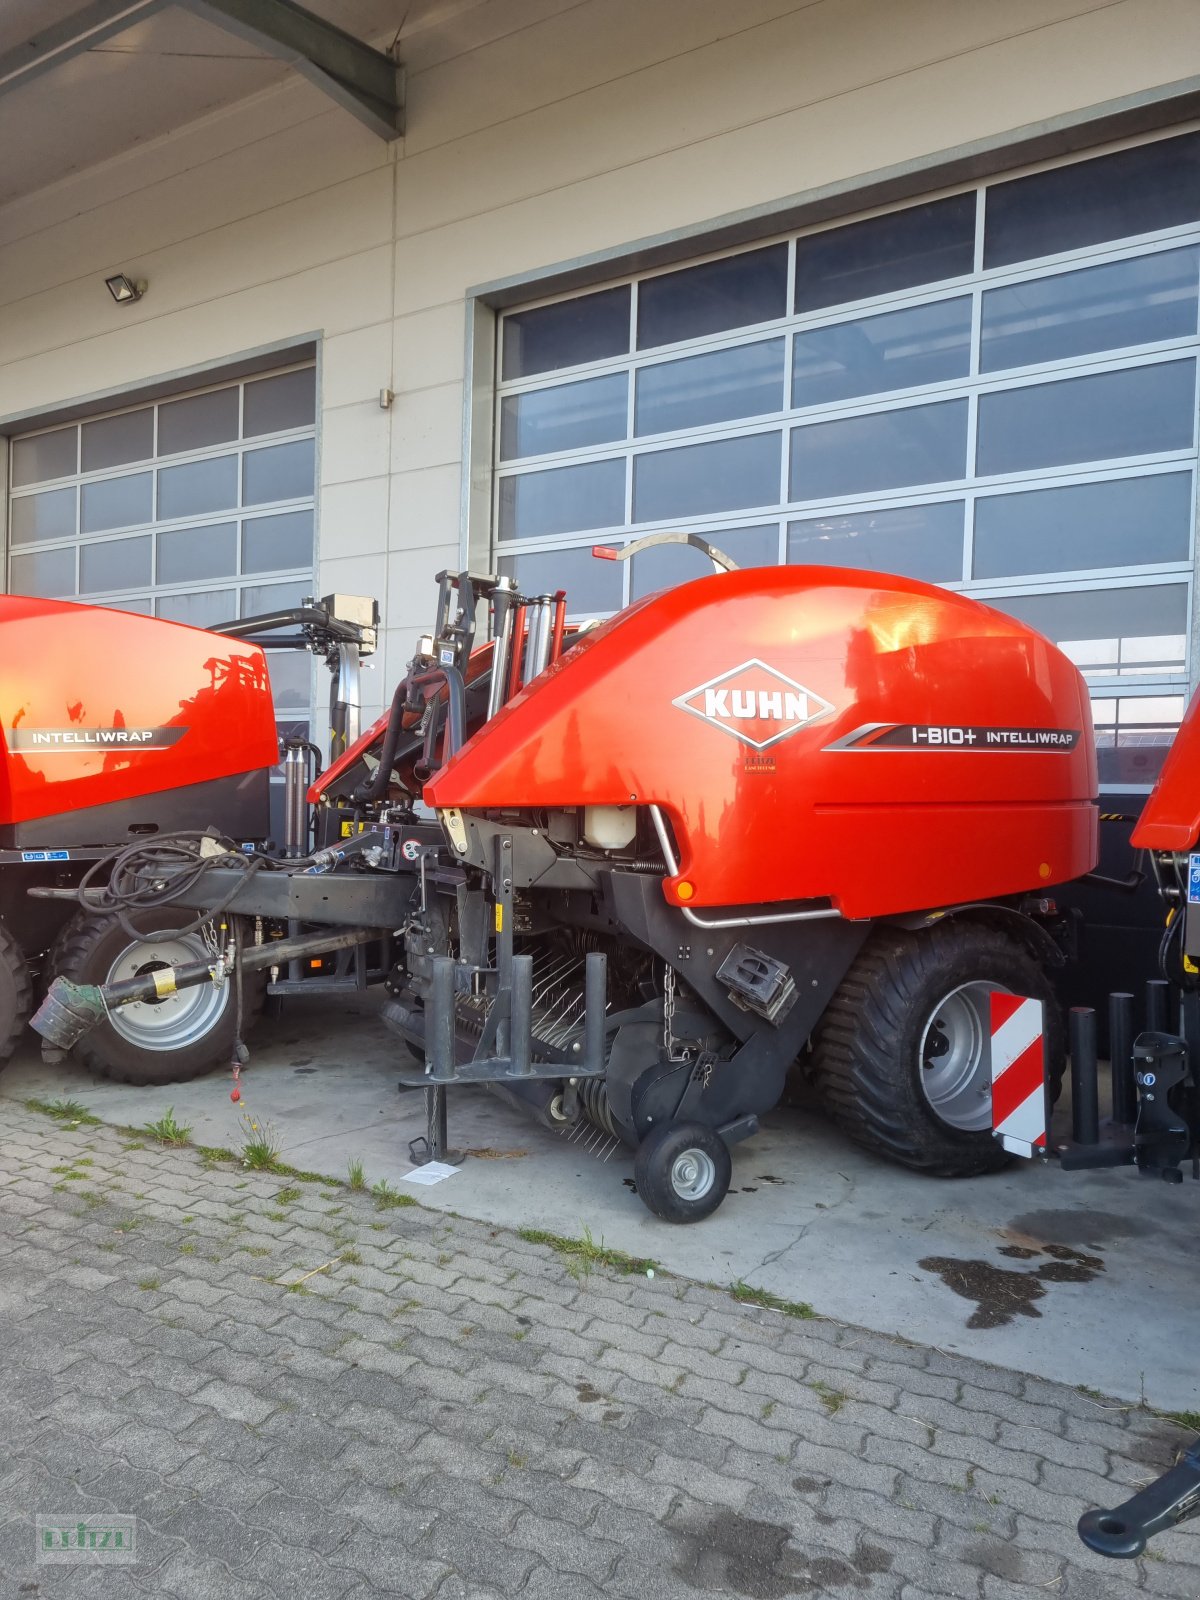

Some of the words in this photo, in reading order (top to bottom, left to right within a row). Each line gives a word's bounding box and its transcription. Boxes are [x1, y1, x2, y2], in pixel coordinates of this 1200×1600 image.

[704, 688, 809, 721] KUHN
[32, 731, 153, 744] INTELLIWRAP
[986, 731, 1073, 745] INTELLIWRAP
